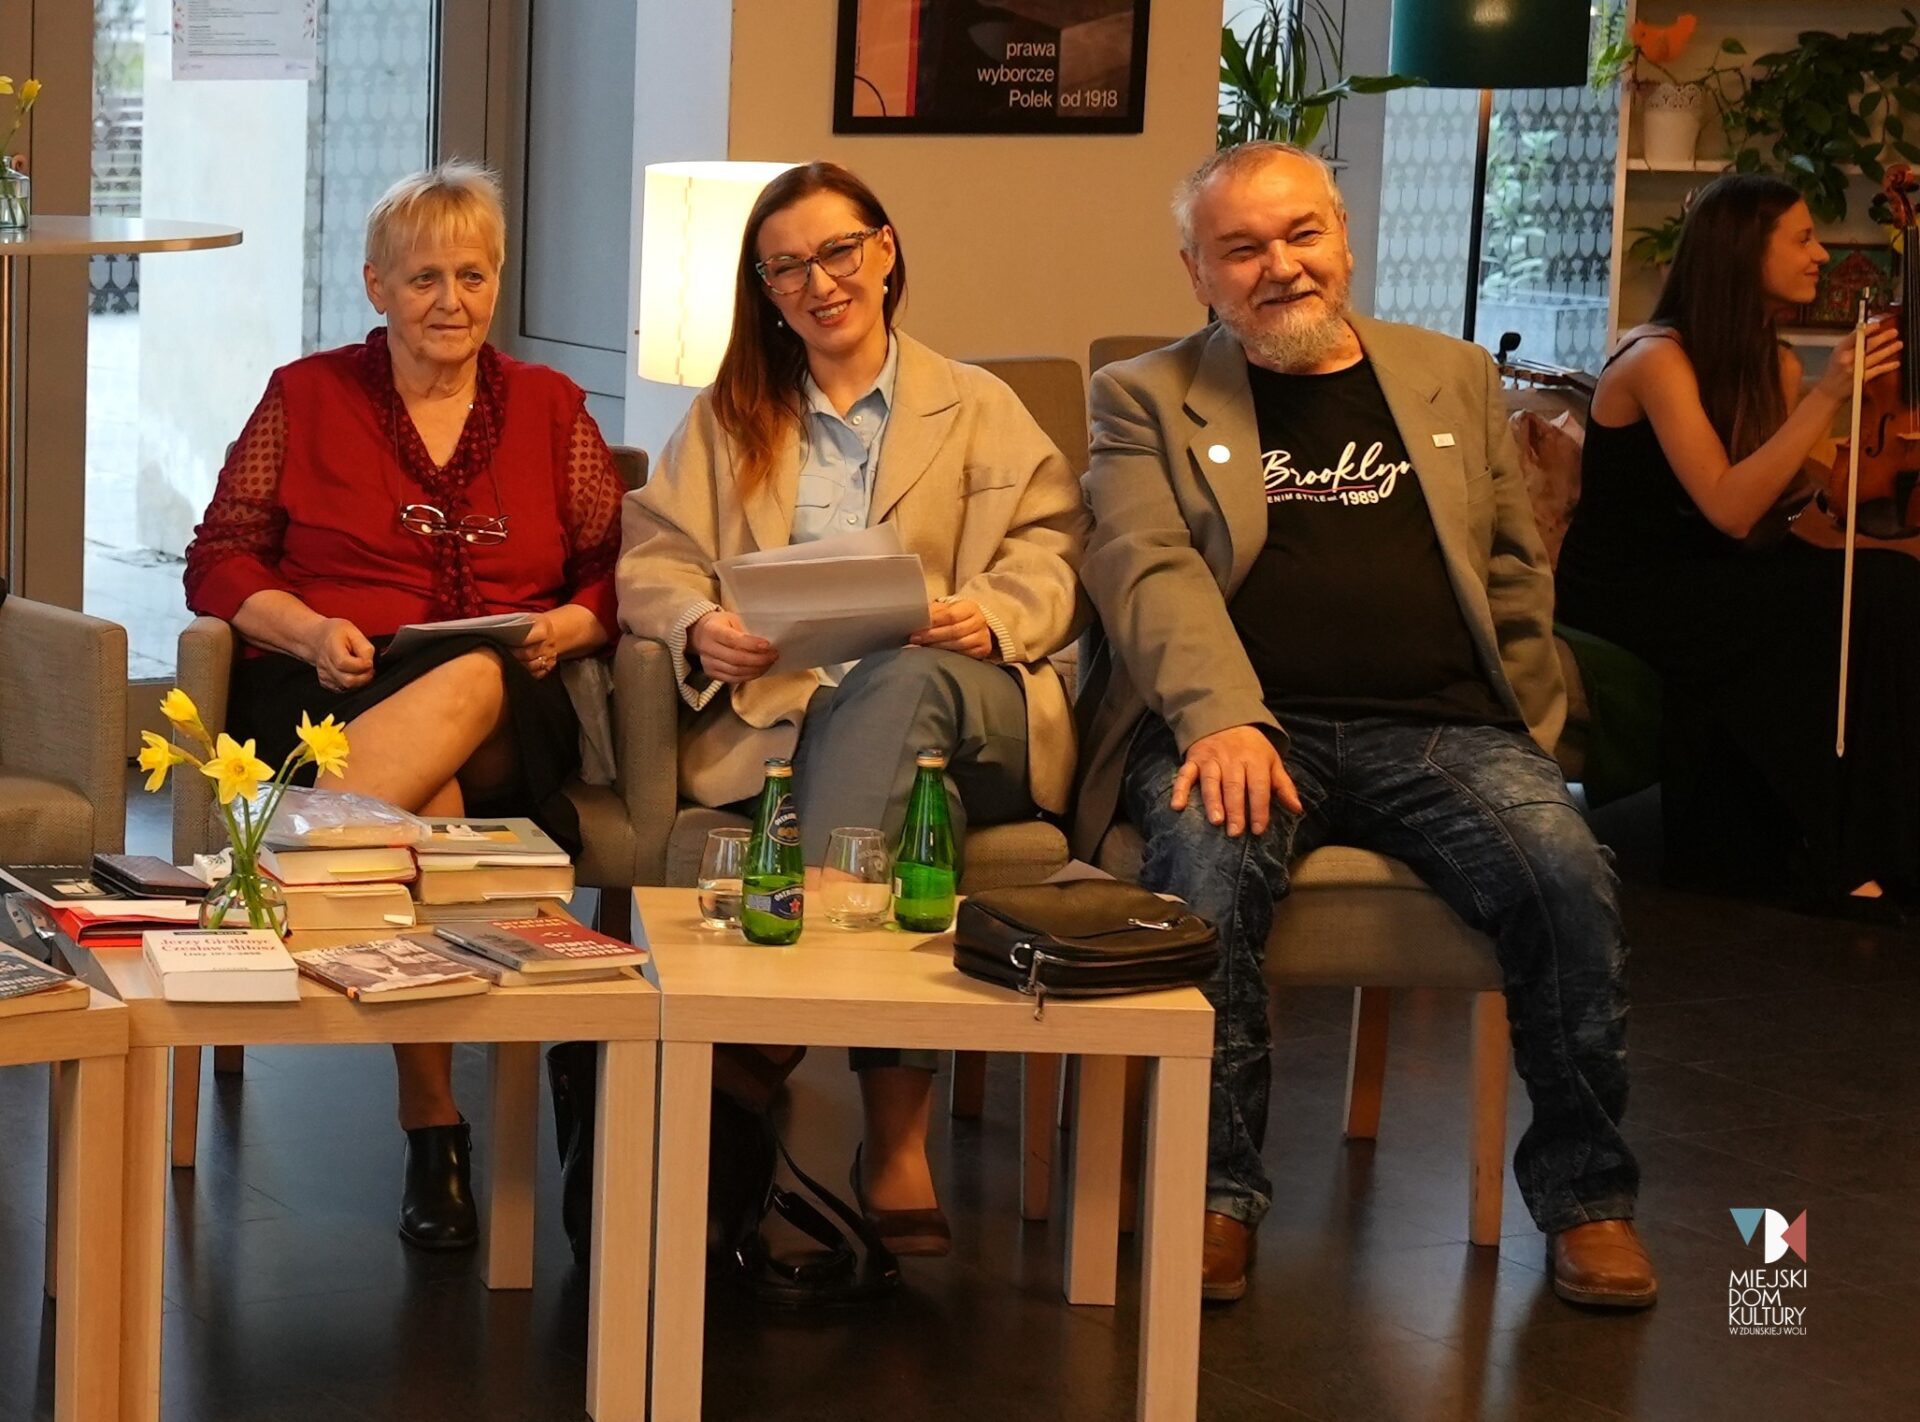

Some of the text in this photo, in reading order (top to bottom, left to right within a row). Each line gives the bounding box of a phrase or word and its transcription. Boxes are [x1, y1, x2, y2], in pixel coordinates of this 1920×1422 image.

[1006, 42, 1056, 60] prawa
[977, 64, 1055, 86] wyborcze
[1009, 89, 1118, 108] Polek od 1918
[1267, 492, 1293, 504] ENIM
[1295, 493, 1326, 503] STYLE
[1338, 489, 1379, 506] 1989
